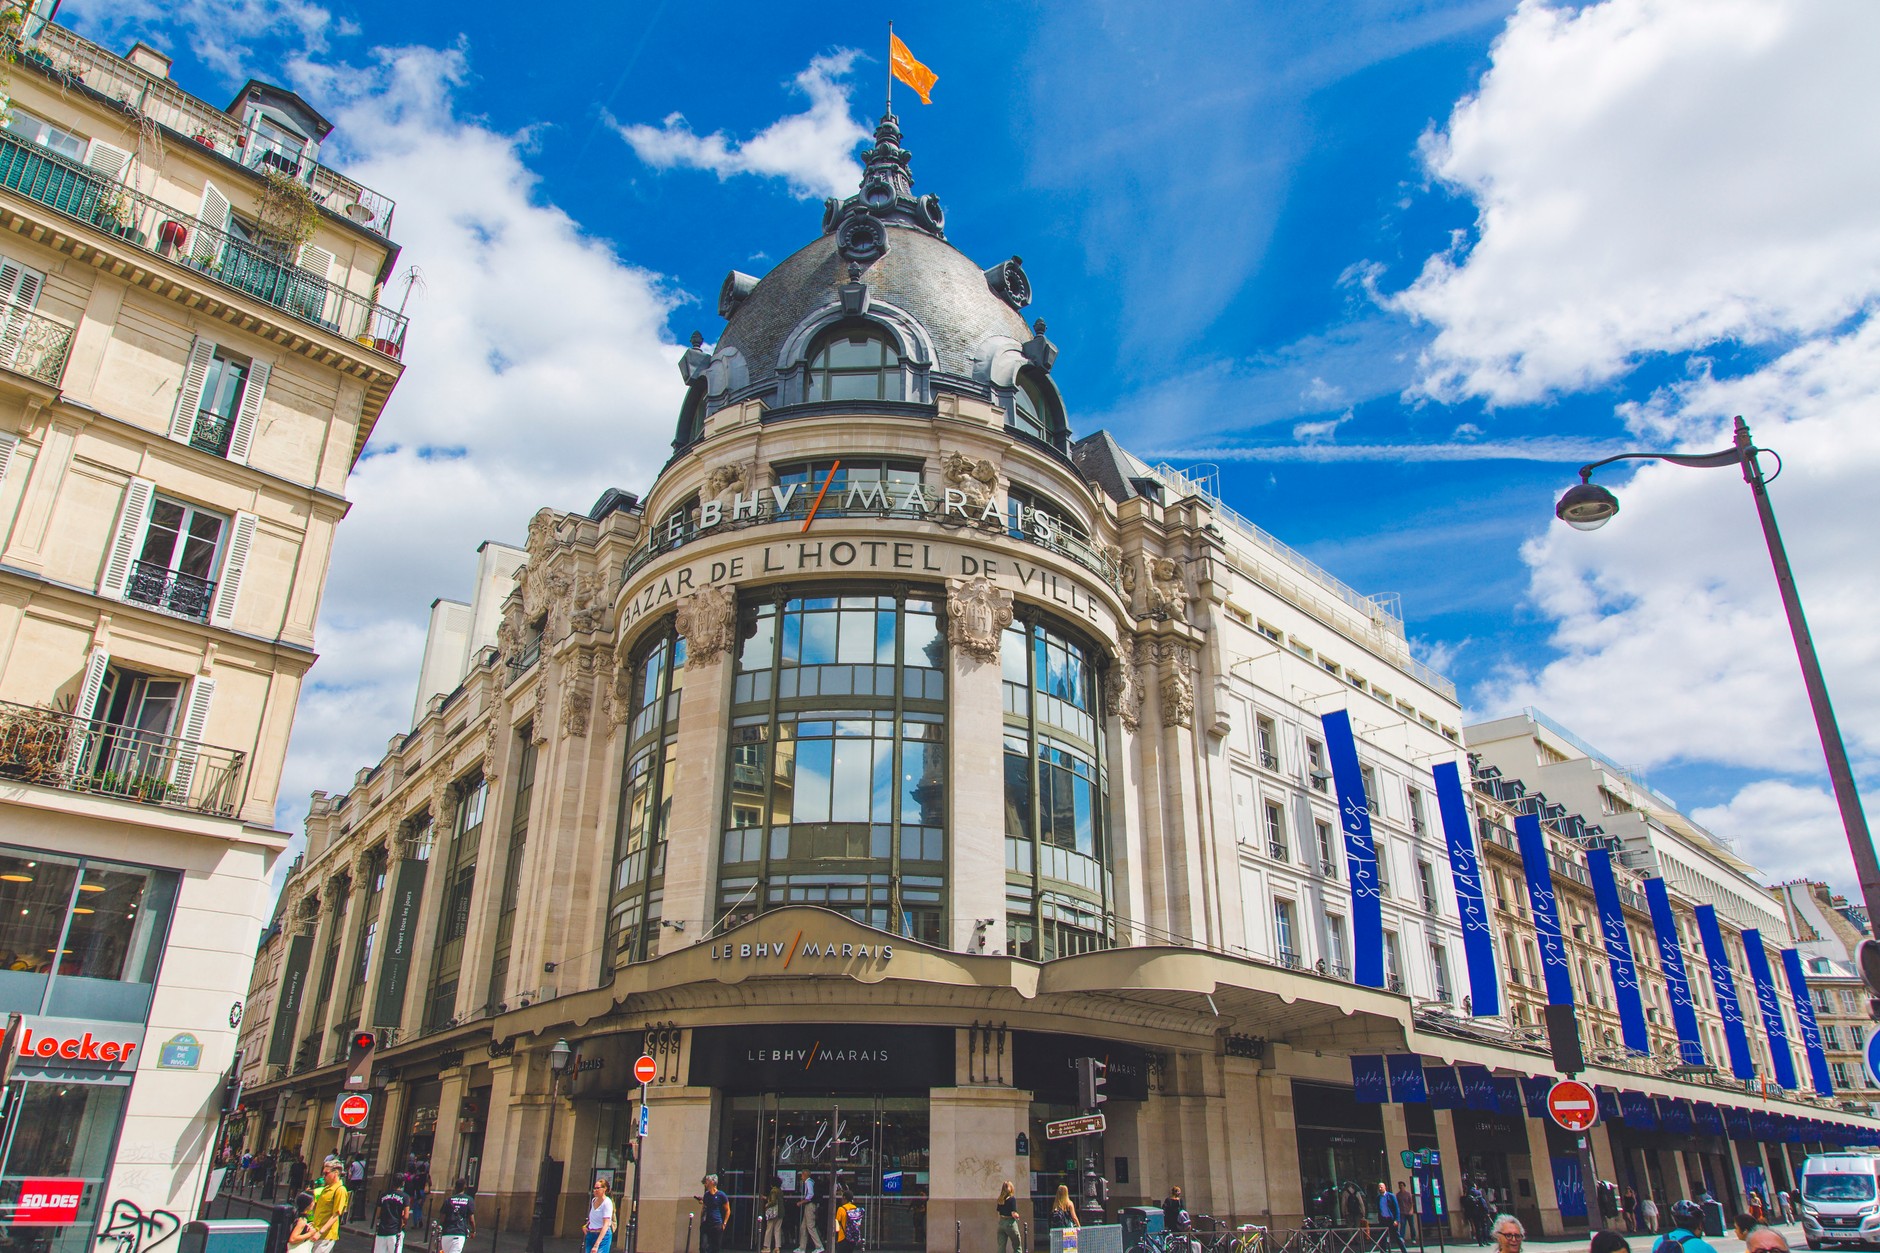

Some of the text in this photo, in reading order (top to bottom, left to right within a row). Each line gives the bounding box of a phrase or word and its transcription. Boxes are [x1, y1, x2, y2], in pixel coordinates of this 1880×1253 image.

[647, 510, 685, 553] LE
[845, 479, 1052, 540] MARAIS
[622, 567, 696, 632] BAZAR
[711, 556, 744, 584] DE
[764, 540, 941, 573] L'HOTEL
[961, 555, 997, 581] DE
[1013, 561, 1098, 623] VILLE
[1343, 796, 1380, 899] soldes
[404, 890, 412, 907] jours
[1452, 840, 1490, 932] soldes
[395, 932, 405, 954] Ouvert
[399, 918, 407, 932] tous
[1531, 883, 1568, 967] soldes
[712, 944, 733, 959] LE
[802, 942, 894, 959] MARAIS
[1603, 912, 1640, 989] soldes
[1660, 937, 1694, 1007] soldes
[290, 981, 298, 996] every
[1711, 958, 1743, 1023] soldes
[19, 1028, 137, 1063] Locker
[748, 1050, 766, 1061] LE
[819, 1050, 889, 1062] MARAIS
[21, 1193, 79, 1208] SOLDES
